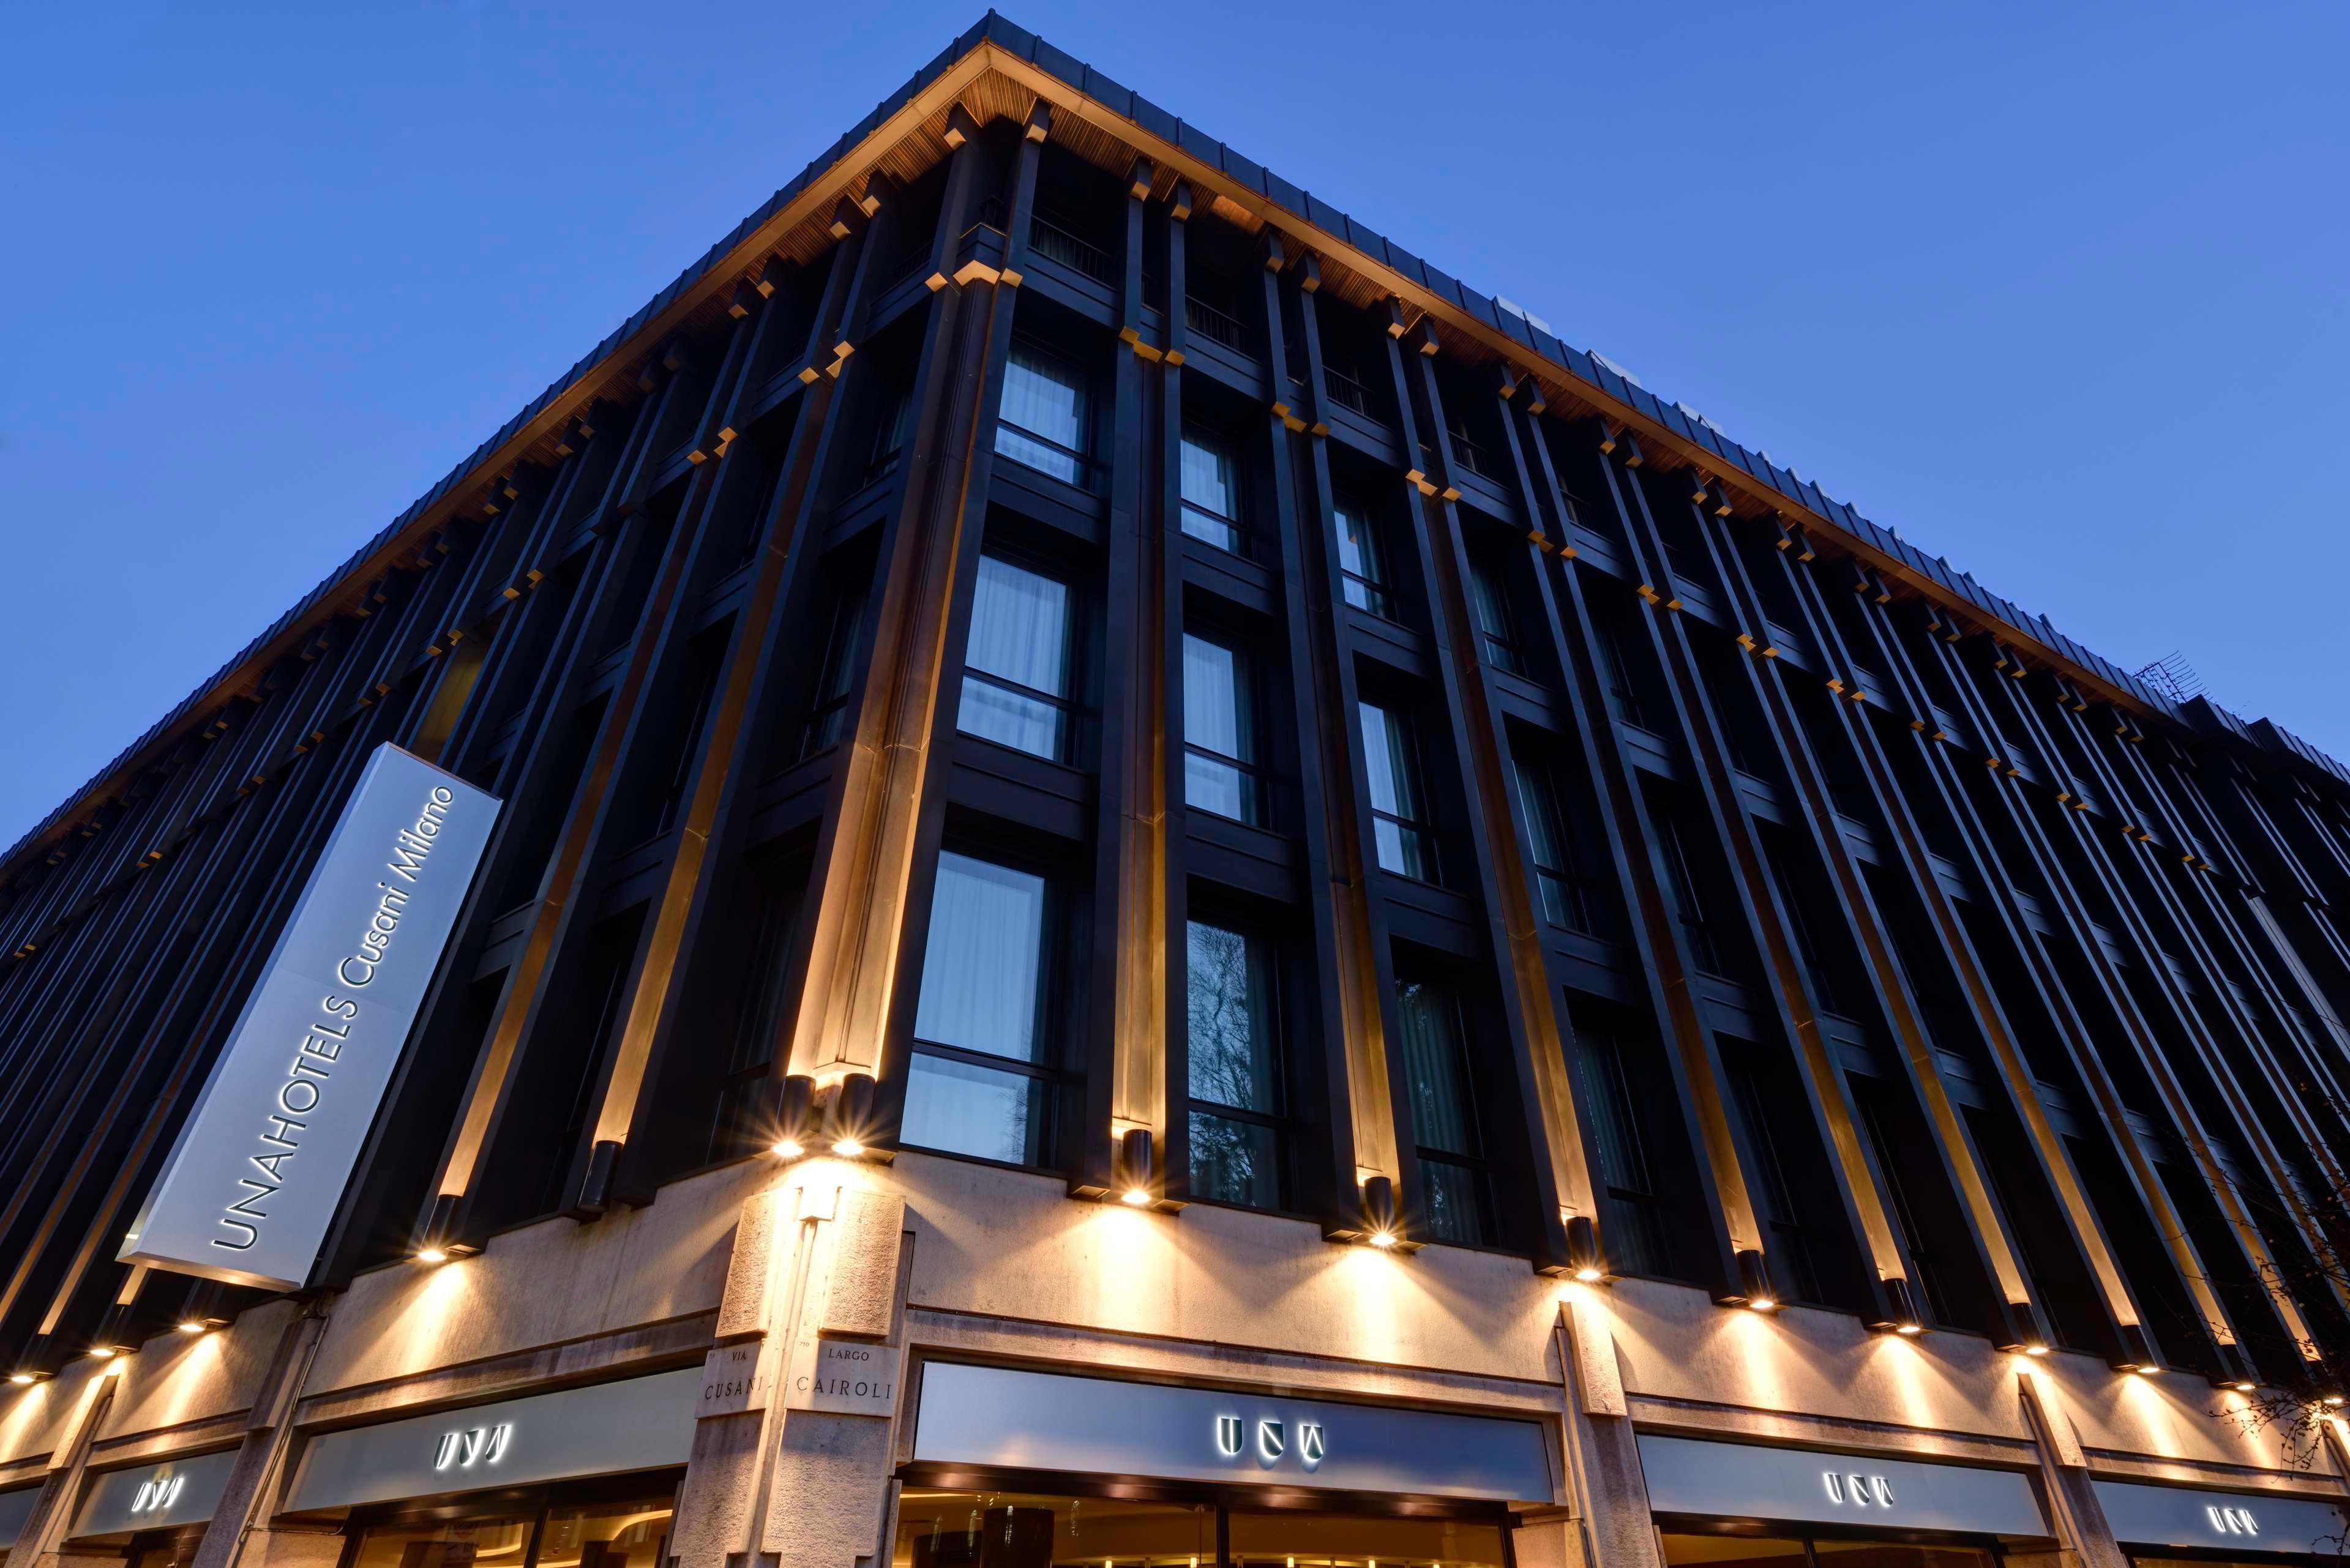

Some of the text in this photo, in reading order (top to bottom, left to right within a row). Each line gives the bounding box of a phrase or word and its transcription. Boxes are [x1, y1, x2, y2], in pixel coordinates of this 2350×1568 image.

[211, 785, 454, 1252] UNAHOTELS Cusani Milano
[732, 1351, 747, 1361] VIA
[828, 1348, 869, 1361] LARGO
[705, 1376, 763, 1400] CUSANI
[796, 1376, 891, 1399] CAIROLI
